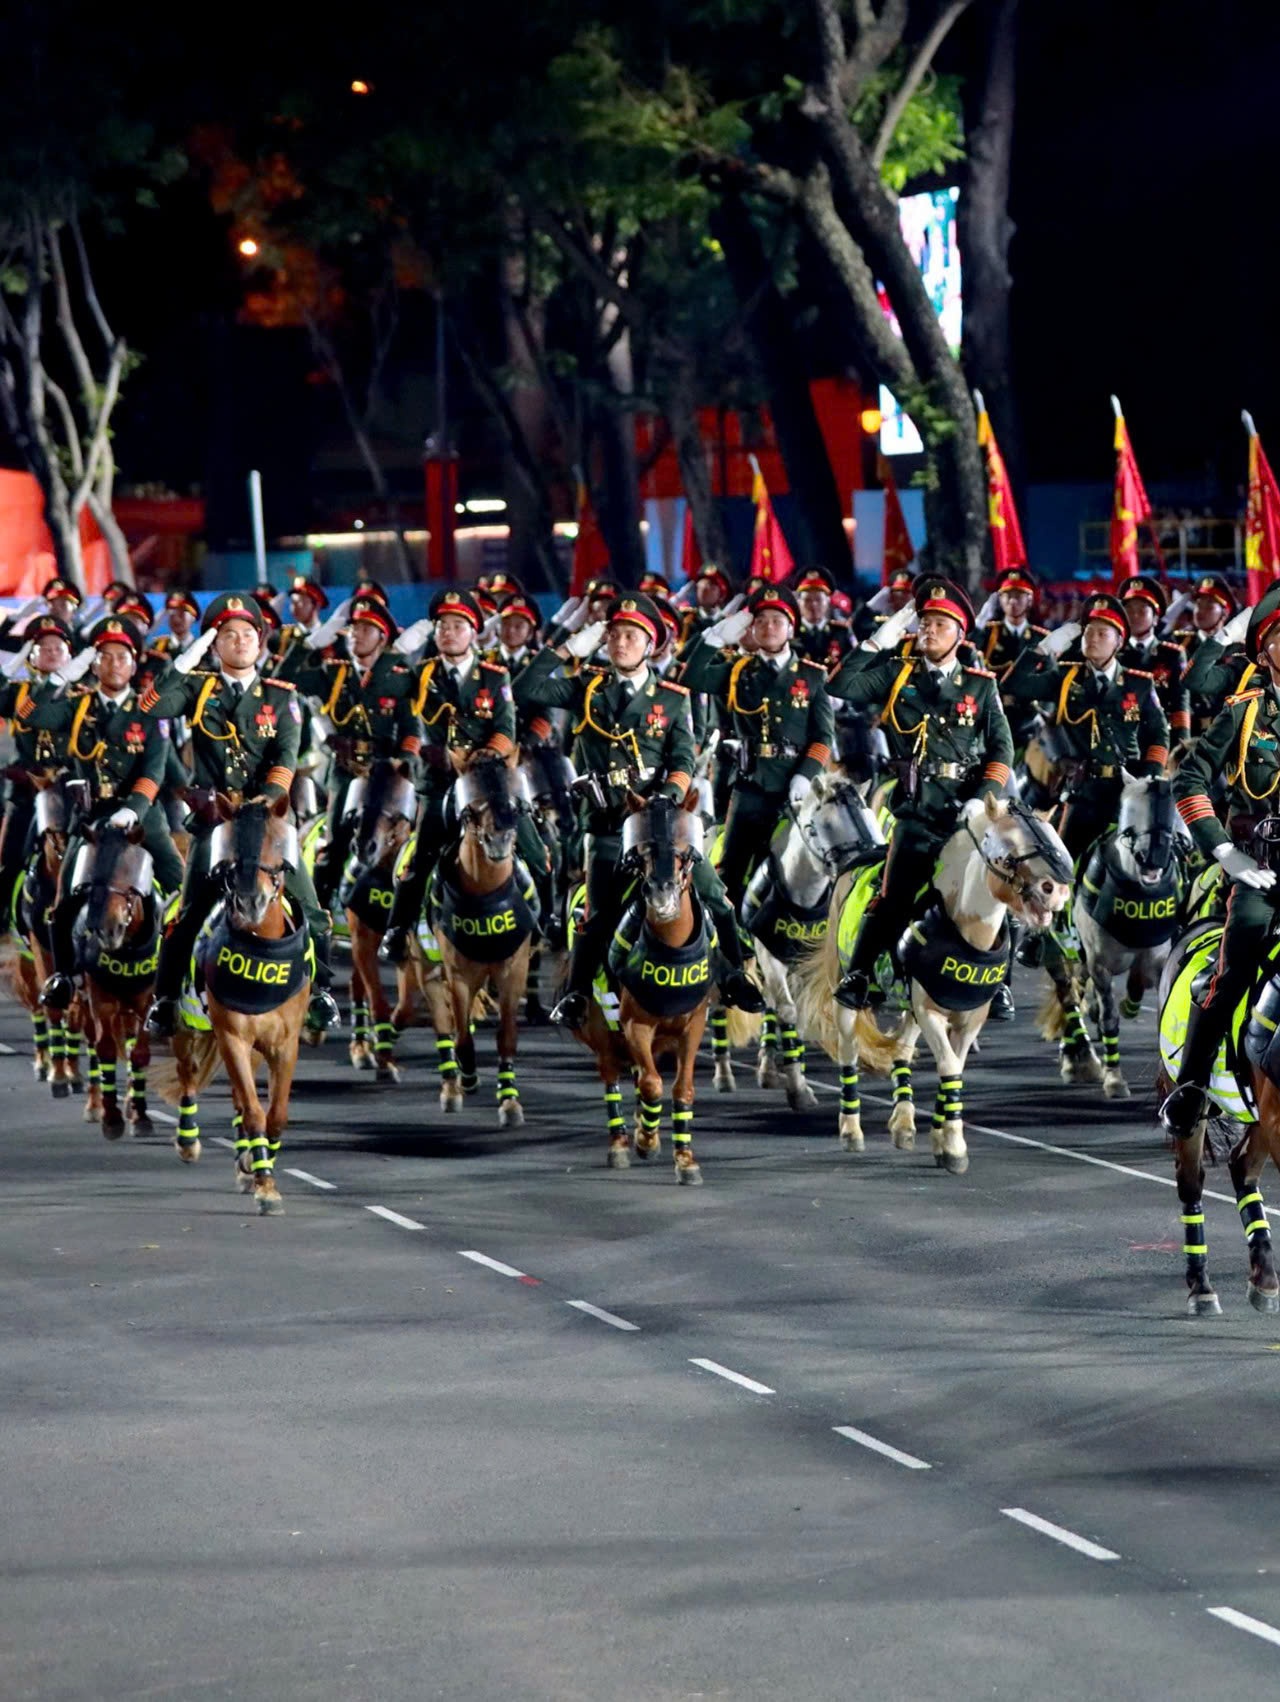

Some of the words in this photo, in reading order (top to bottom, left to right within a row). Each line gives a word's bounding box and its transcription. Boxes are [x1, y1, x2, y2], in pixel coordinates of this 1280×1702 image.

[1113, 896, 1176, 919] POLICE
[451, 909, 517, 936] POLICE
[774, 918, 830, 940] POLIC
[217, 946, 291, 985] POLICE
[641, 958, 709, 987] POLICE
[940, 956, 1007, 985] POLICE
